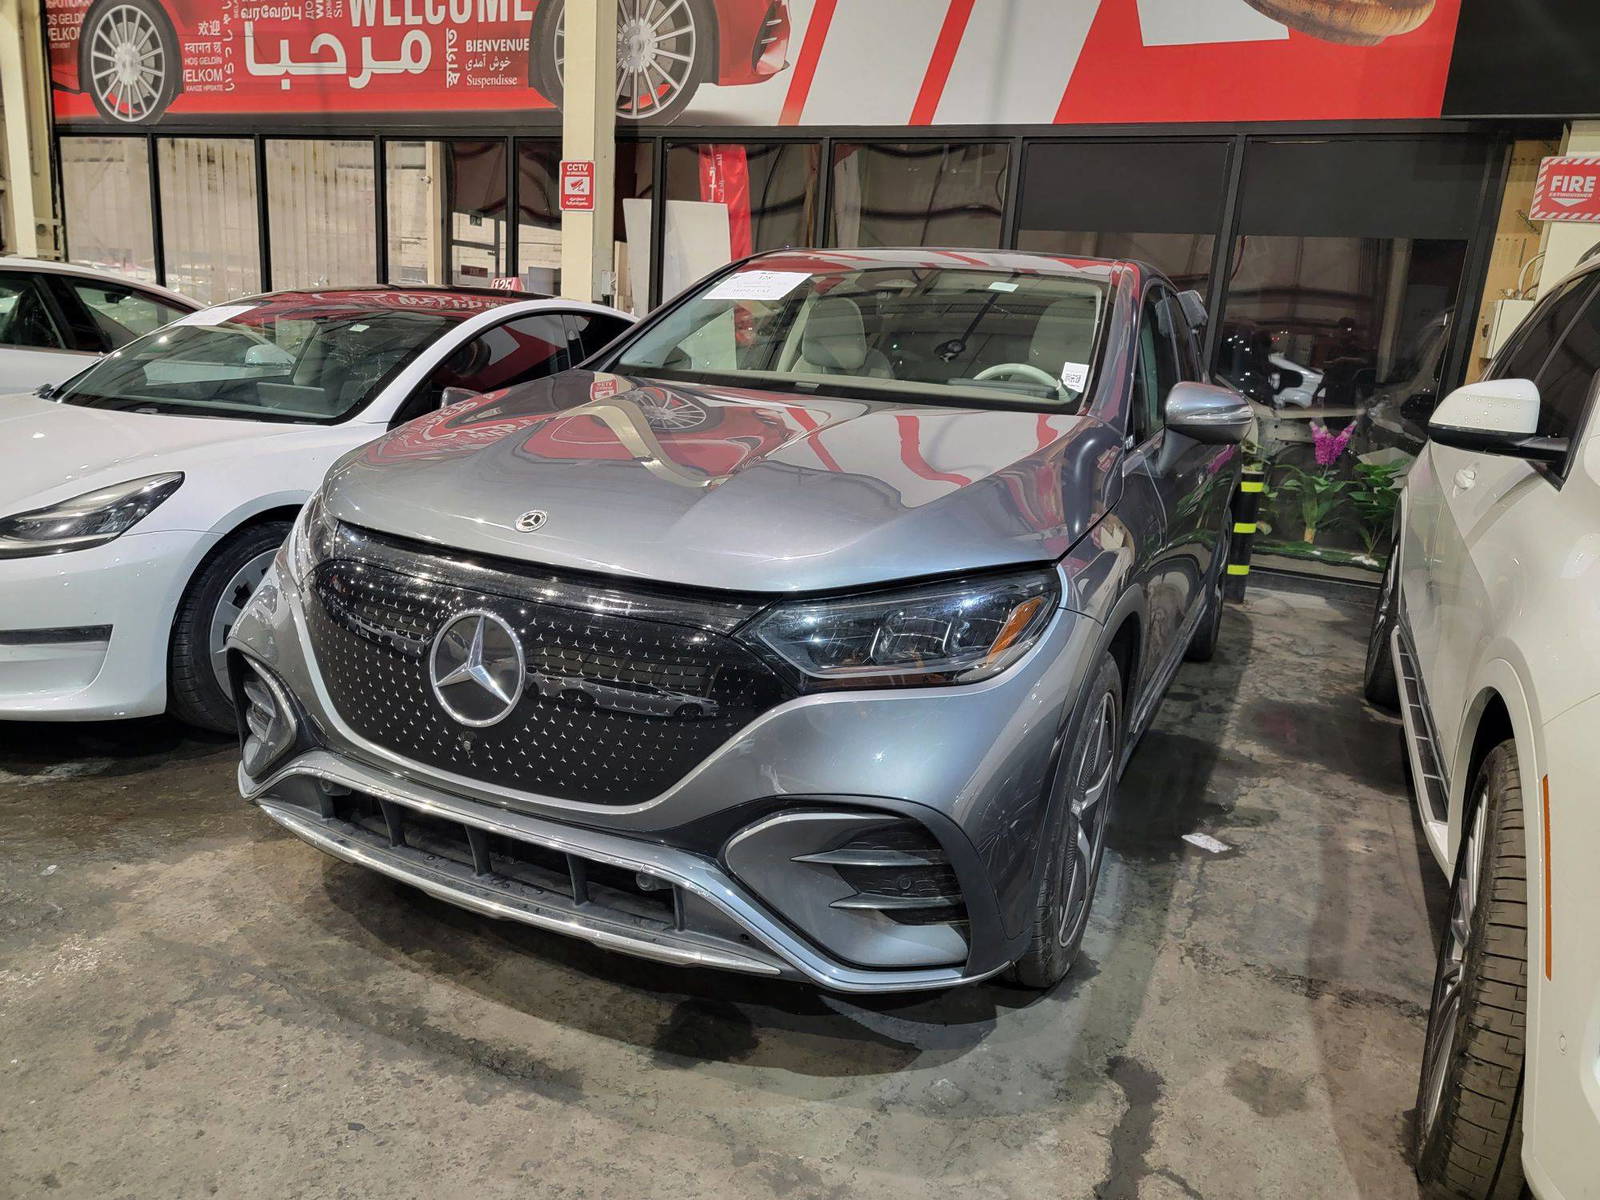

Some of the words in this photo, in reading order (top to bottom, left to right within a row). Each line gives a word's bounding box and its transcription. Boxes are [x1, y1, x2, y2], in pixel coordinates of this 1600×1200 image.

[198, 20, 221, 36] 欢迎
[465, 38, 530, 53] BIENVENUE
[244, 20, 432, 90] مرحبا
[489, 55, 512, 71] خوش
[466, 73, 518, 89] Suspendisse
[566, 163, 589, 172] CCTV
[1549, 175, 1597, 193] FIRE
